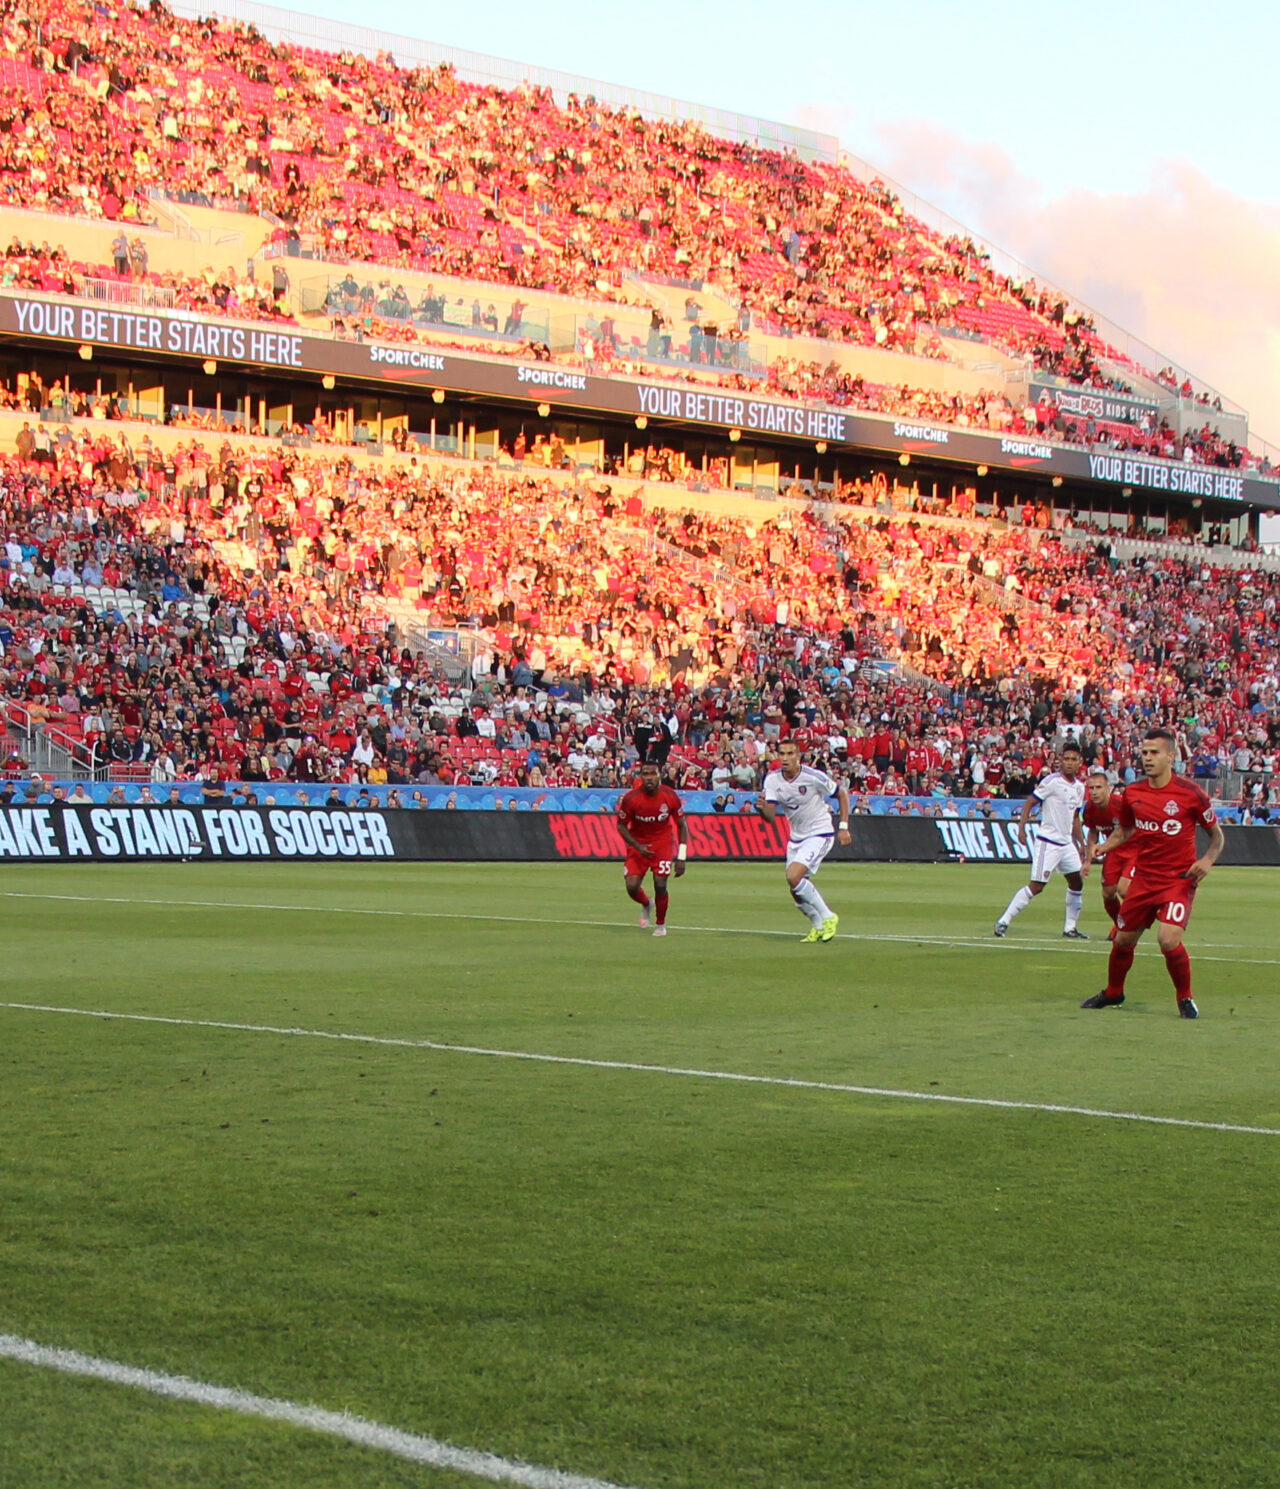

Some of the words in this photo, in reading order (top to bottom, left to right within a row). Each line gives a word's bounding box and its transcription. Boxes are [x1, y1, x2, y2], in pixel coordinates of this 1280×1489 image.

[14, 300, 75, 338] YOUR
[81, 308, 162, 349] BETTER
[168, 320, 245, 360] STARTS
[251, 331, 303, 367] HERE
[637, 386, 681, 417] YOUR
[685, 393, 744, 426] BETTER
[748, 403, 804, 435] STARTS
[807, 411, 846, 441] HERE
[1106, 402, 1126, 419] KIDS
[1089, 454, 1121, 481] YOUR
[1124, 462, 1168, 490] BETTER
[1170, 468, 1212, 497] STARTS
[1215, 476, 1244, 501] HERE
[64, 809, 93, 857] A
[94, 809, 204, 856] STAND
[203, 809, 267, 857] FOR
[269, 810, 395, 857] SOCCER
[936, 820, 993, 858] TAKE
[991, 822, 1014, 858] A
[658, 860, 672, 874] 55
[806, 851, 815, 862] 3
[1166, 901, 1185, 922] 10
